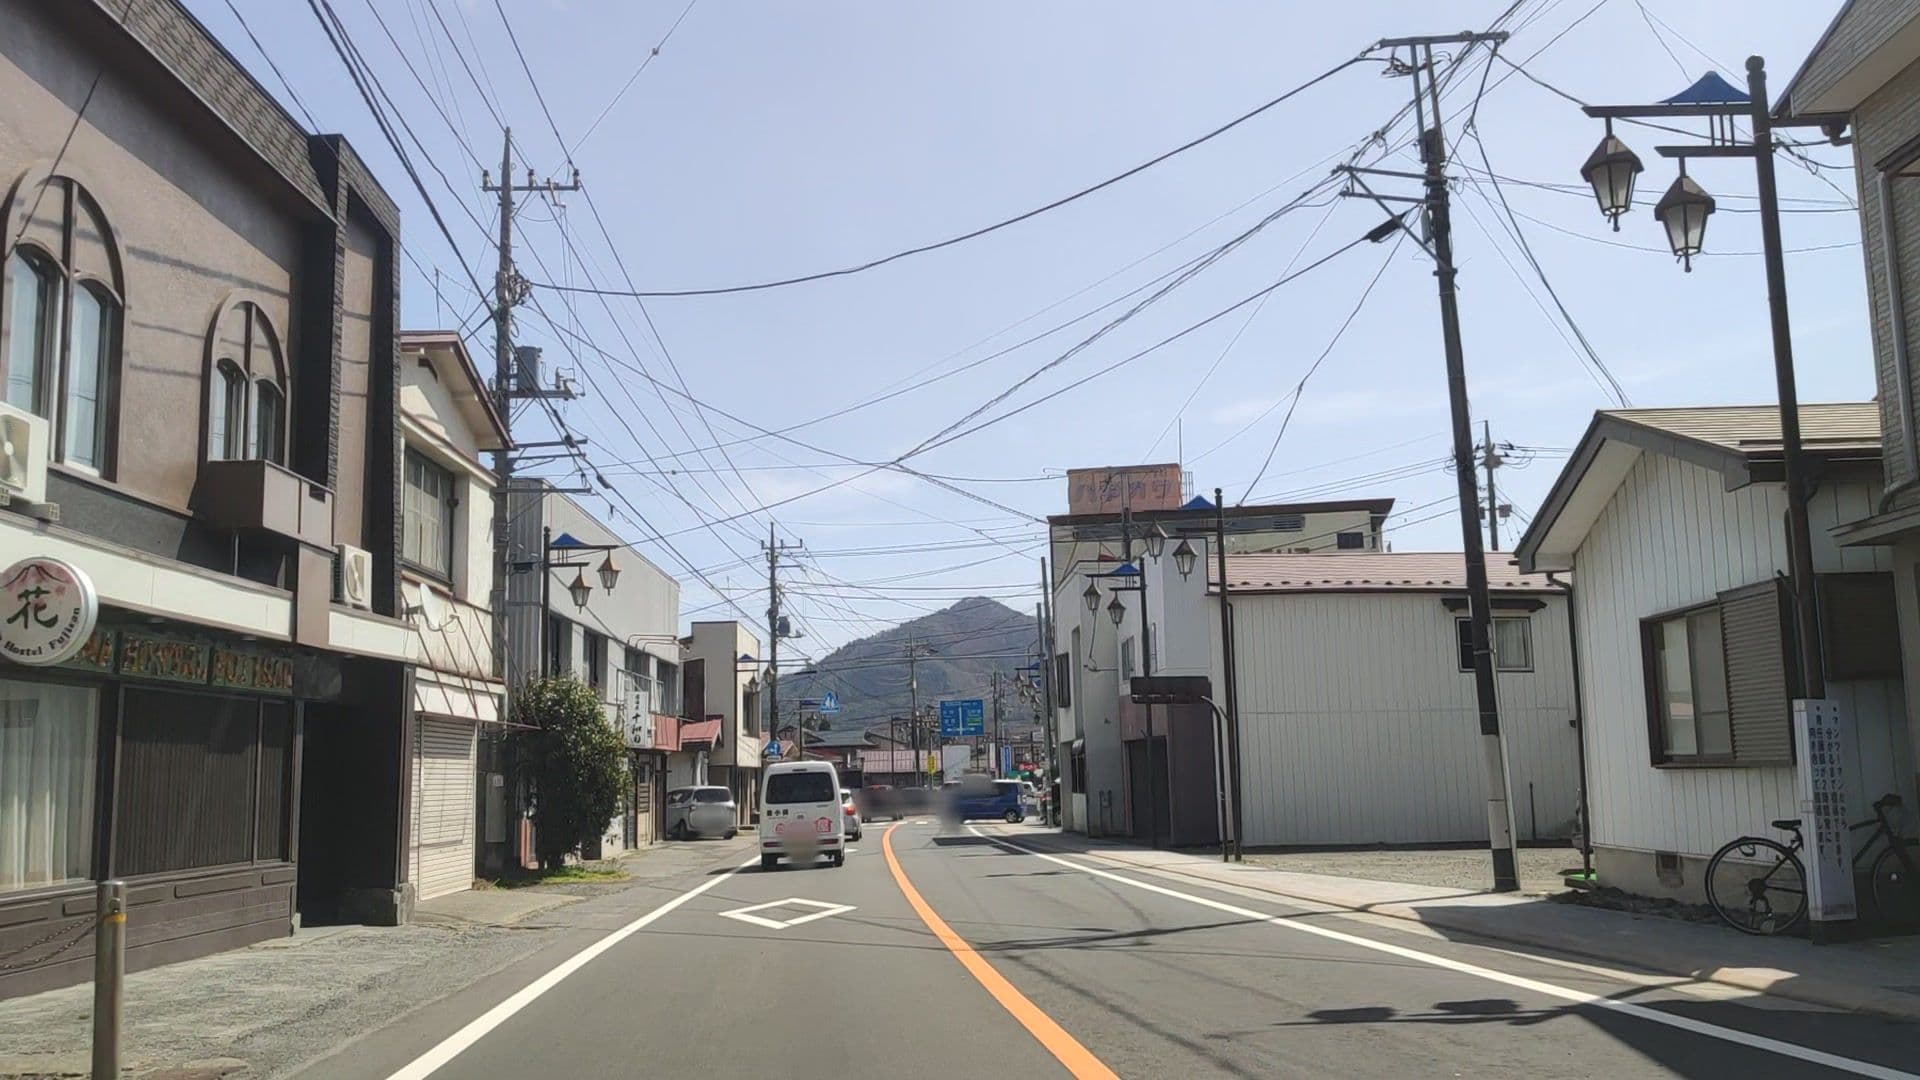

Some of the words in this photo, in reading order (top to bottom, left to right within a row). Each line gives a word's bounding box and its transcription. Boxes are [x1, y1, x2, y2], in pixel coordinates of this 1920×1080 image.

[6, 586, 59, 630] 花
[4, 640, 42, 657] Hostel
[48, 607, 81, 650] Fujisan
